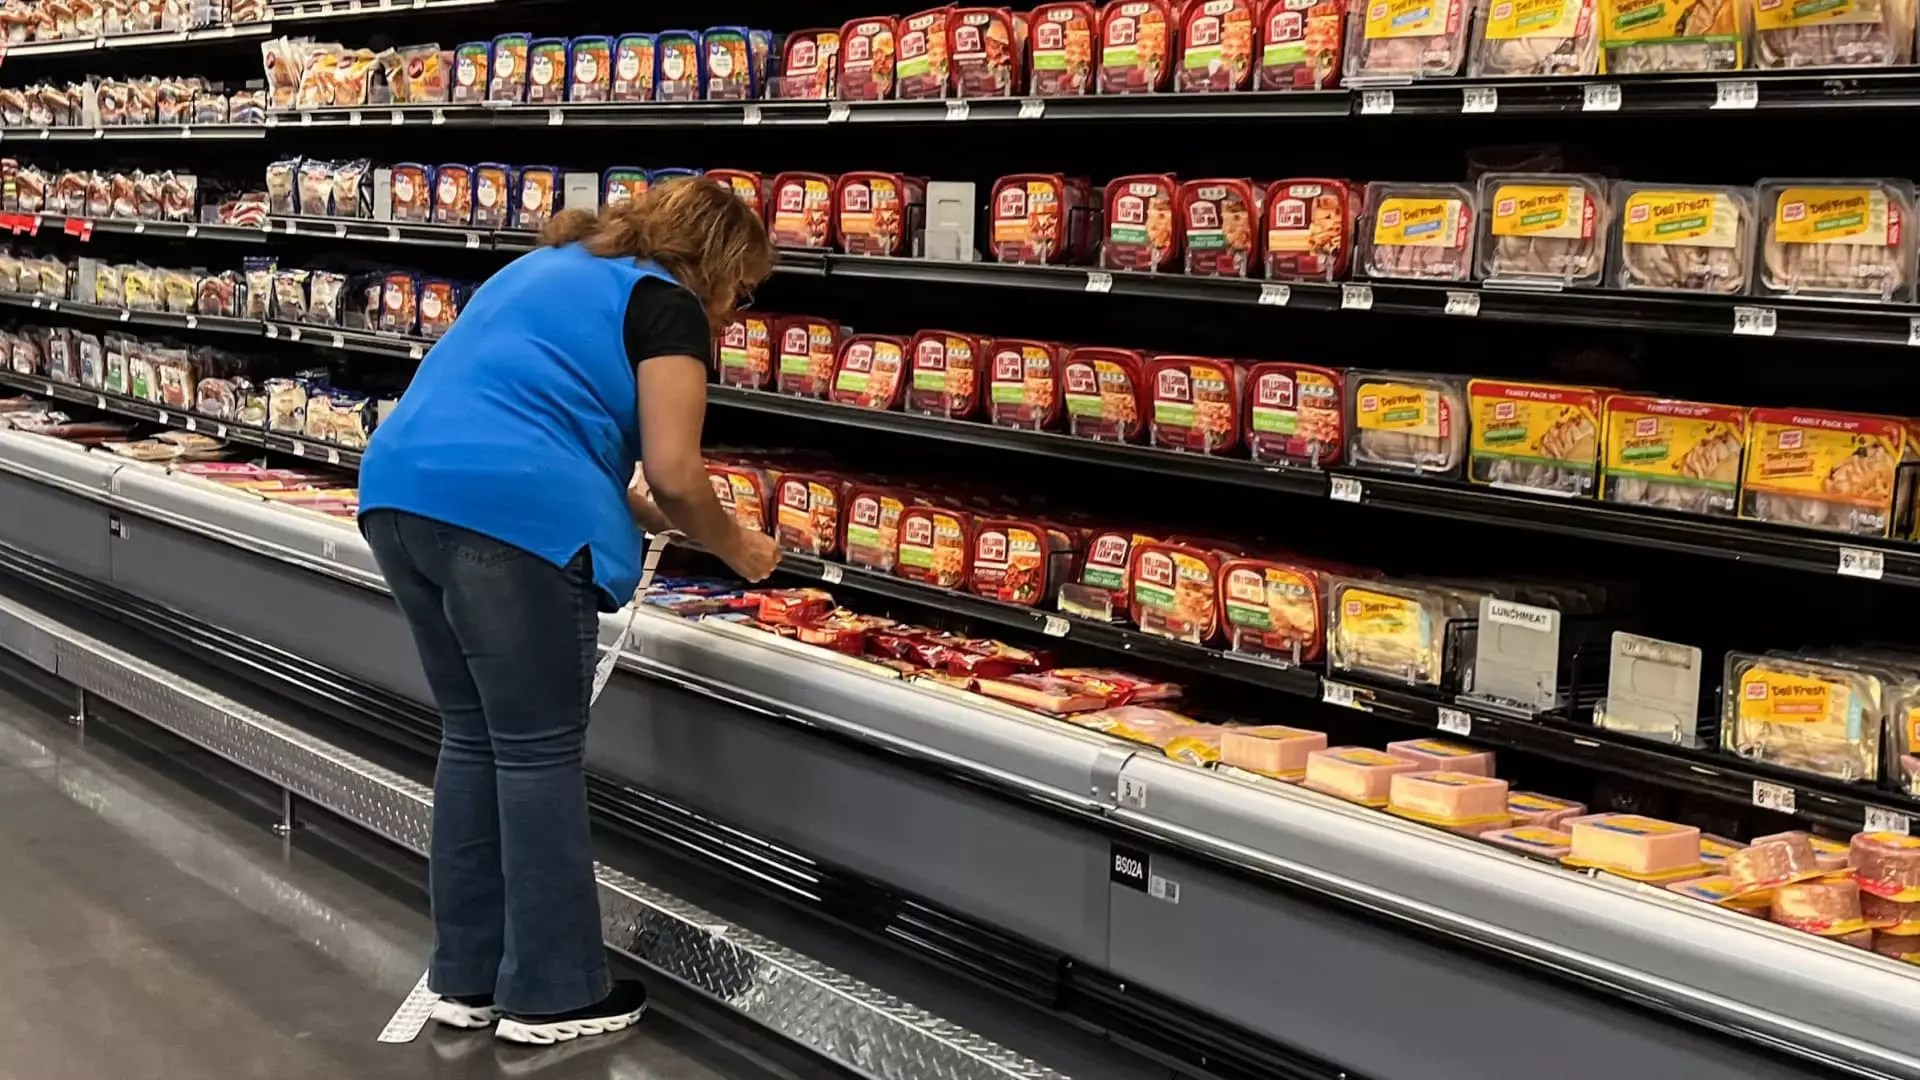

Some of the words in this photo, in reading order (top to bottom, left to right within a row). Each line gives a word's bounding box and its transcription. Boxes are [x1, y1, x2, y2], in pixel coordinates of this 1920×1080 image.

[1653, 203, 1675, 218] Deli
[1677, 197, 1710, 213] Fresh
[1491, 605, 1547, 624] LUNCHMEAT
[1771, 685, 1793, 697] Deli
[1795, 685, 1824, 696] Fresh
[1115, 854, 1144, 879] BS02A
